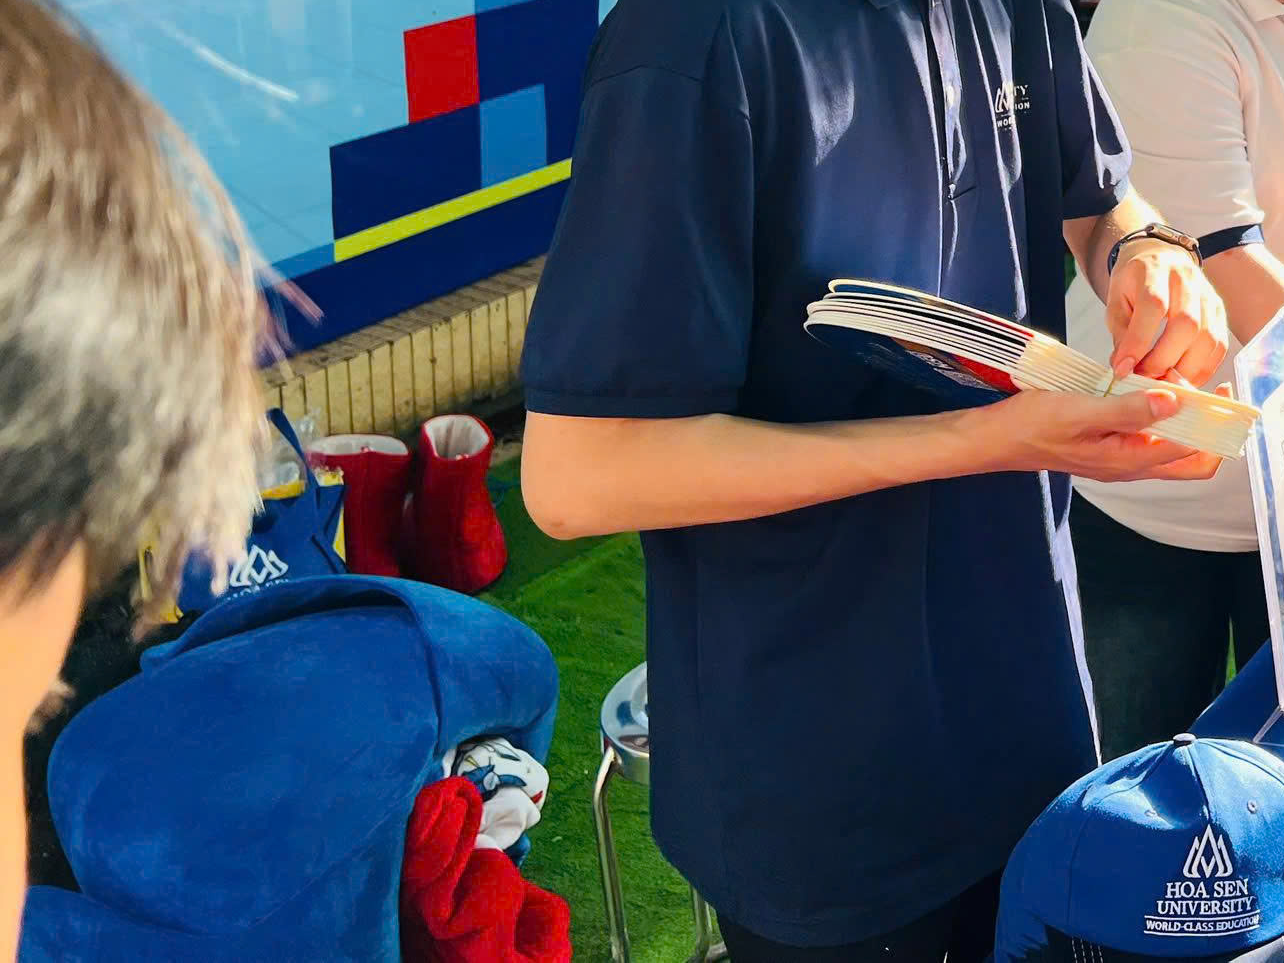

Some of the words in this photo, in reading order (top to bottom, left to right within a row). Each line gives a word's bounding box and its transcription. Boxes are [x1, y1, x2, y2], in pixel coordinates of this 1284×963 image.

[1165, 881, 1210, 898] HOA
[1213, 878, 1249, 897] SEN
[1156, 897, 1255, 915] UNIVERSITY
[1215, 914, 1260, 931] EDUCATION
